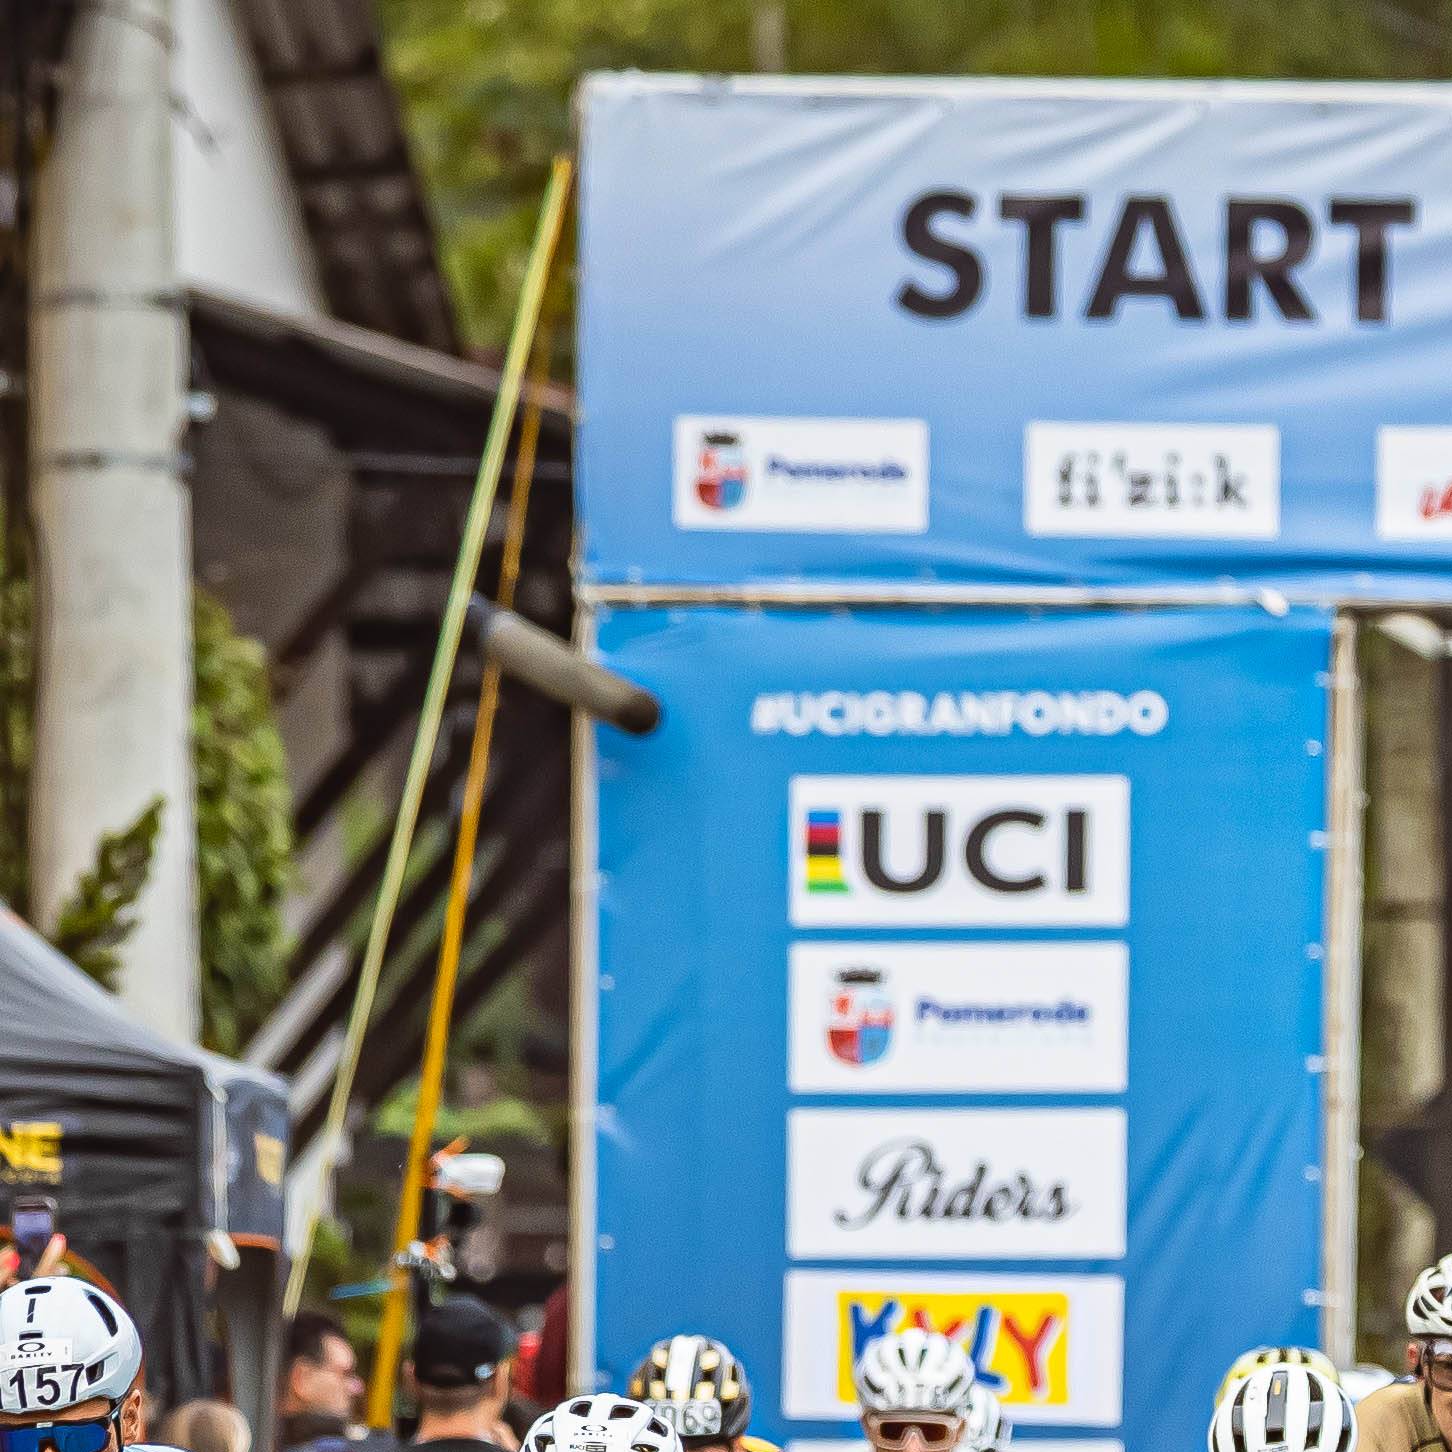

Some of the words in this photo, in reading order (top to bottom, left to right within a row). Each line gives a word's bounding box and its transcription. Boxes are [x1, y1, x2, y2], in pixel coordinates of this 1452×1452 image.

[894, 188, 1421, 323] START
[751, 690, 1170, 738] #UCIGRANFONDO
[860, 809, 1088, 894] UCI
[834, 1136, 1079, 1231] Riders
[0, 1363, 85, 1410] 157
